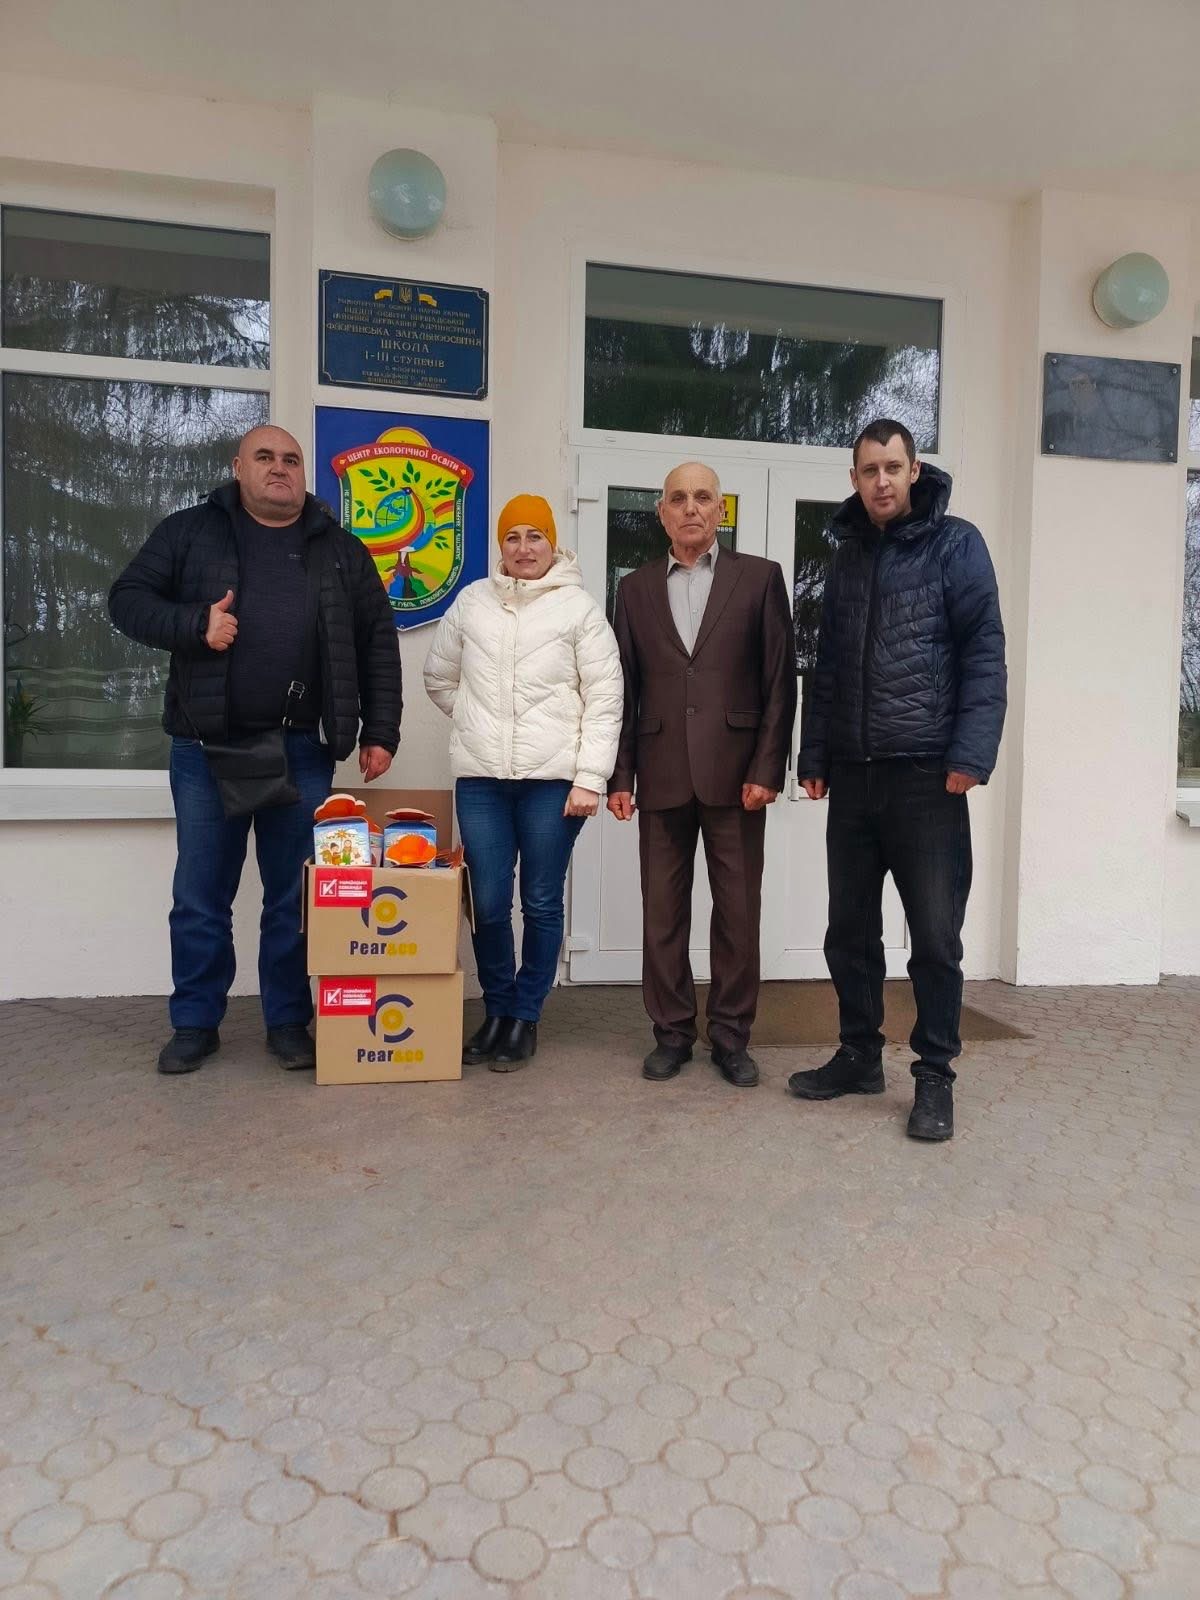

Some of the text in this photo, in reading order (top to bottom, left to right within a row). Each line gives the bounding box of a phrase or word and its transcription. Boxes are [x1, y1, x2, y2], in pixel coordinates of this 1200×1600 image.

[381, 339, 429, 353] ШКОЛА
[393, 355, 445, 368] СТУПЕНІВ
[347, 446, 459, 471] ЦЕНТР ЕКОЛОГІЧНОЇ ОСВІТИ
